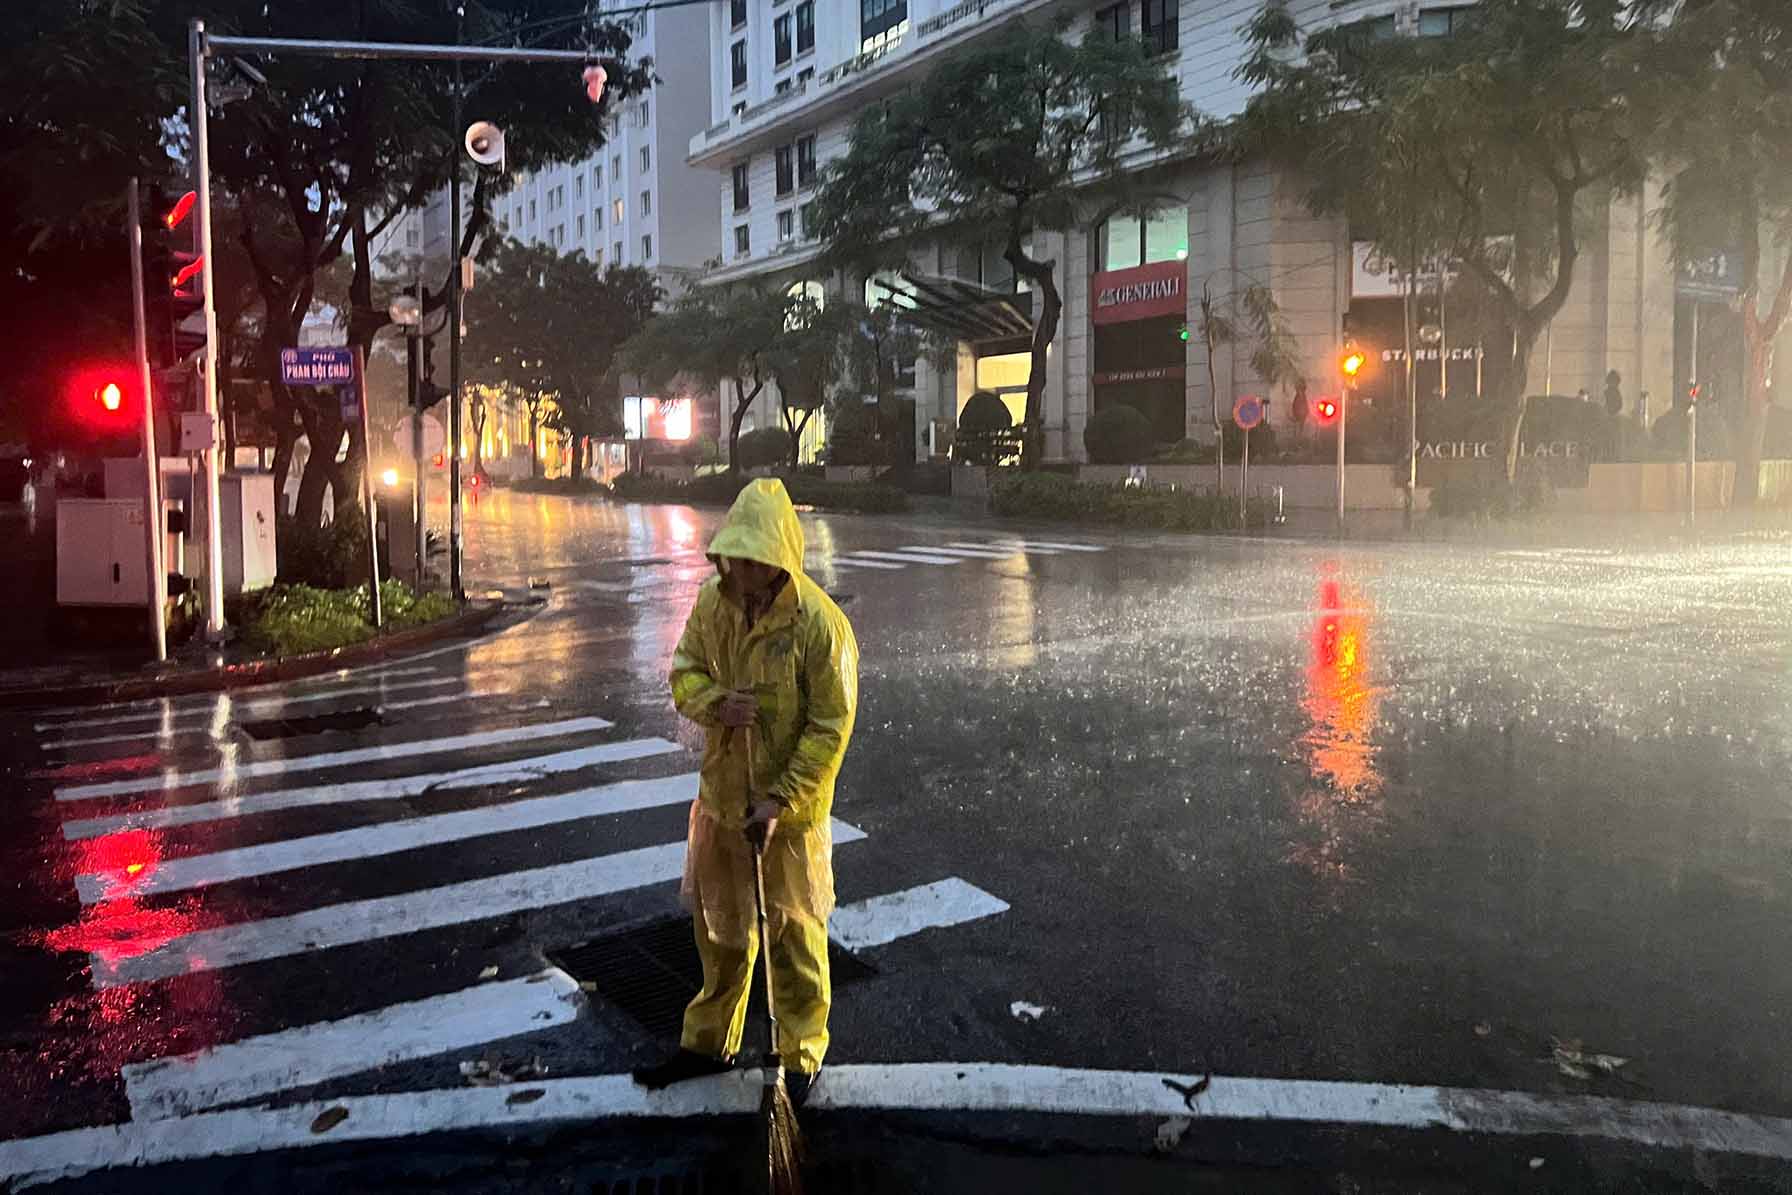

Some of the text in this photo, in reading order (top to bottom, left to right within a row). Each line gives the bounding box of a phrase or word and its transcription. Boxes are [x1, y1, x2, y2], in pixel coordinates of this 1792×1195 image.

[1116, 277, 1180, 303] GENERALI
[286, 364, 311, 379] PHAN
[1412, 440, 1578, 458] PACIFIC LACE
